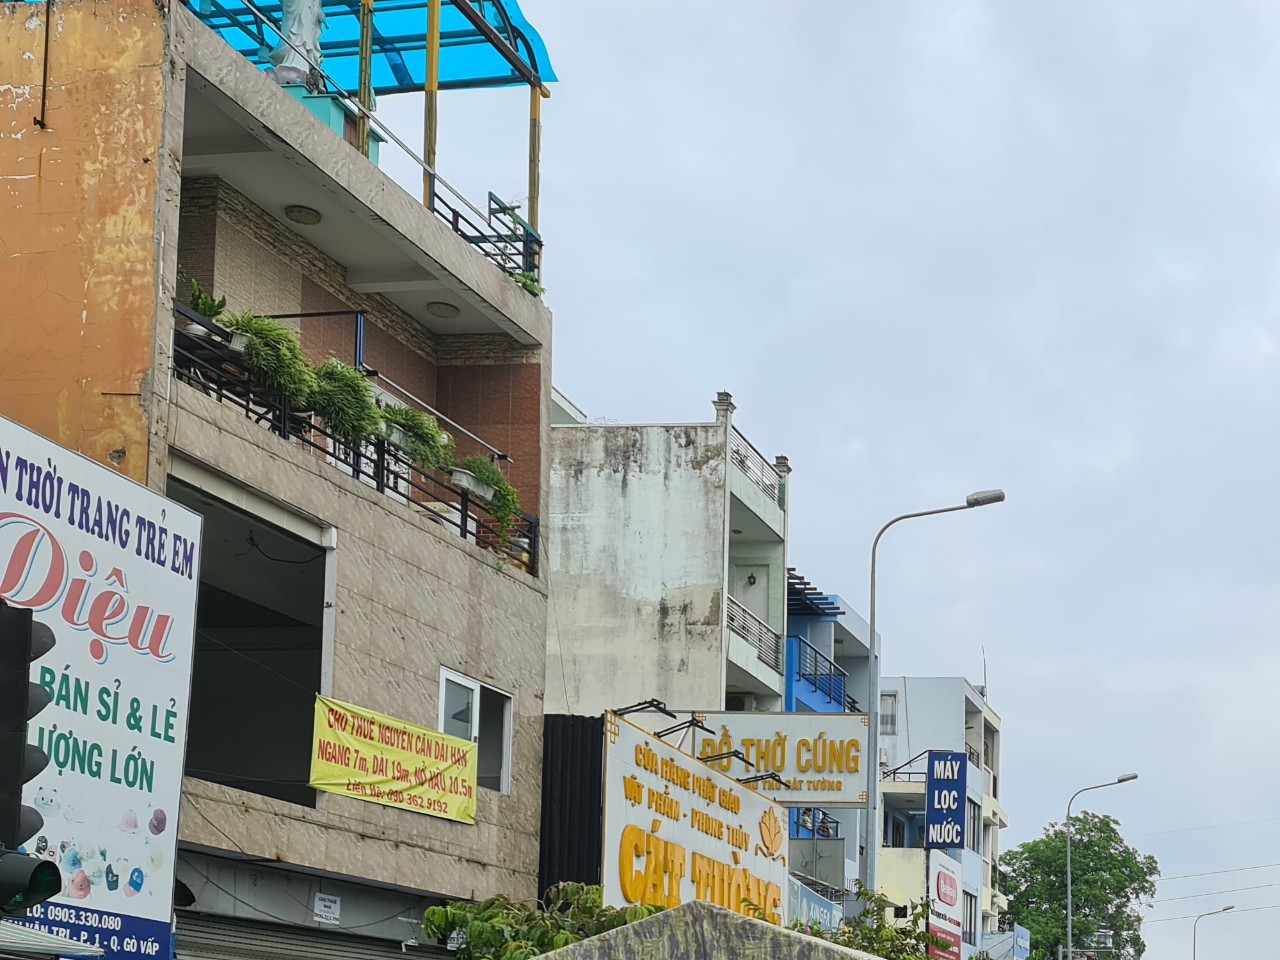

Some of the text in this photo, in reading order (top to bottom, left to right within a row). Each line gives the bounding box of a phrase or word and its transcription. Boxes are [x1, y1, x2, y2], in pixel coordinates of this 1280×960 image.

[15, 456, 64, 519] THỜI
[68, 482, 130, 549] TRANG
[135, 509, 168, 567] TRẺ
[171, 533, 195, 580] EM
[0, 512, 174, 662] Diệu
[40, 664, 177, 744] BÁN SỈ & LẺ
[38, 724, 154, 793] ƯỢNG LỚN
[317, 739, 351, 768] NGANG
[353, 749, 369, 777] 7m,
[372, 751, 388, 778] DÀI
[391, 760, 412, 787] 19m,
[428, 767, 446, 794] HẬU
[328, 708, 468, 770] CHO THUÊ NGUYÊN CĂN DÀI HẠN
[700, 724, 861, 773] ĐỒ THỜ CÚNG
[933, 755, 961, 780] MÁY
[346, 779, 367, 795] Liên
[407, 793, 424, 808] 362
[427, 800, 448, 813] 9192
[623, 774, 644, 808] VẬT
[648, 784, 680, 821] PHẨM
[691, 808, 724, 840] PHONG
[635, 741, 741, 815] CỬA HÀNG PHẬT GIÁO
[933, 790, 958, 814] LỌC
[929, 818, 961, 843] NƯỚC
[619, 819, 782, 927] CÁT TƯỜNG
[48, 905, 121, 931] 0903.330.080
[94, 933, 101, 948] 1
[110, 936, 121, 952] Q.
[124, 935, 138, 952] GÒ
[140, 937, 160, 956] VẤP
